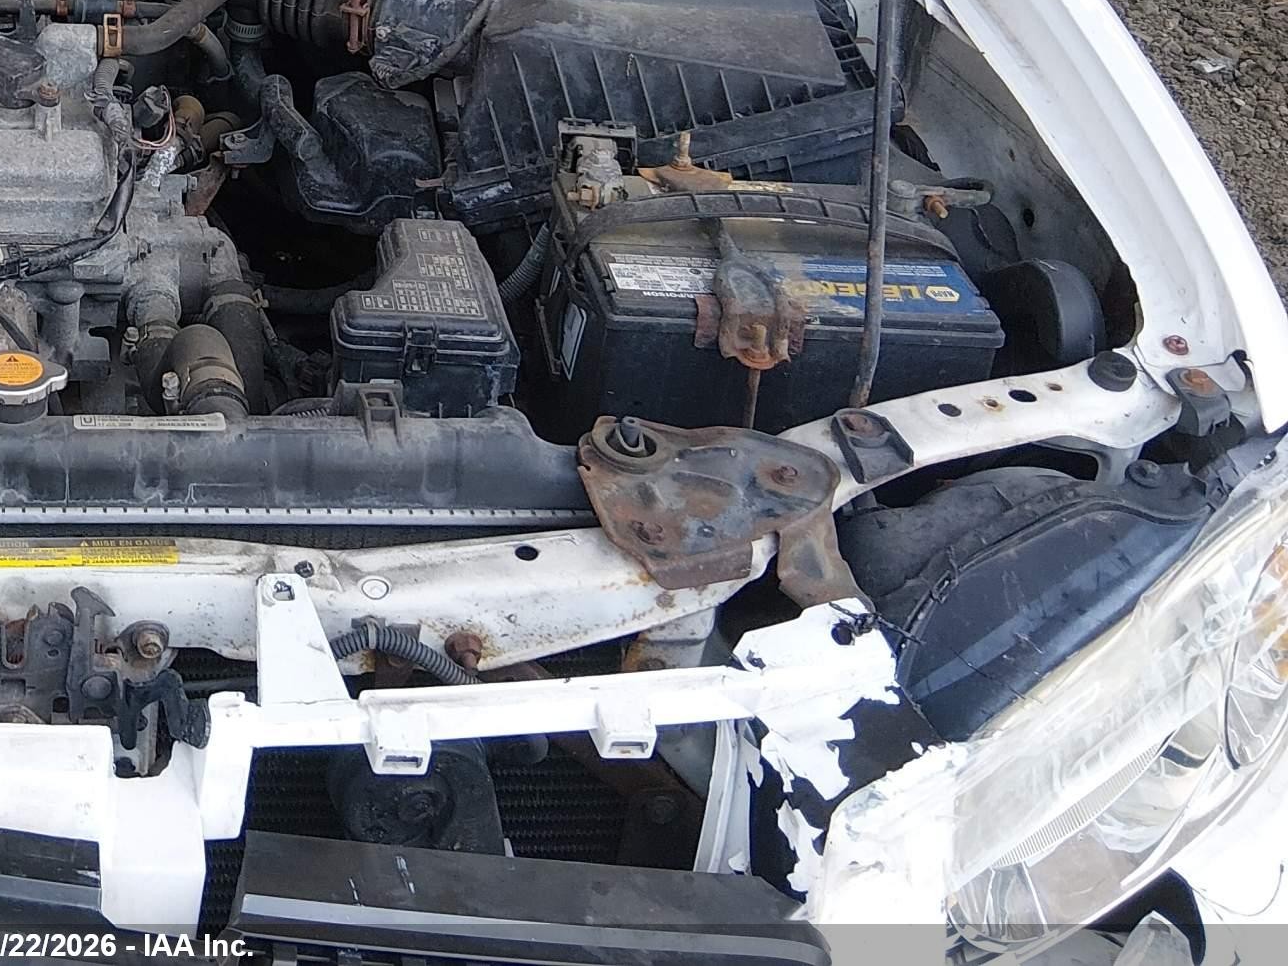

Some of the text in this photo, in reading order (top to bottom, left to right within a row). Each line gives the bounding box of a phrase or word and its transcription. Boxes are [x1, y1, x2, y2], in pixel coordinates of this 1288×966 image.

[796, 278, 956, 301] LEEN NAPA
[91, 539, 116, 547] MISE
[119, 539, 132, 547] EN
